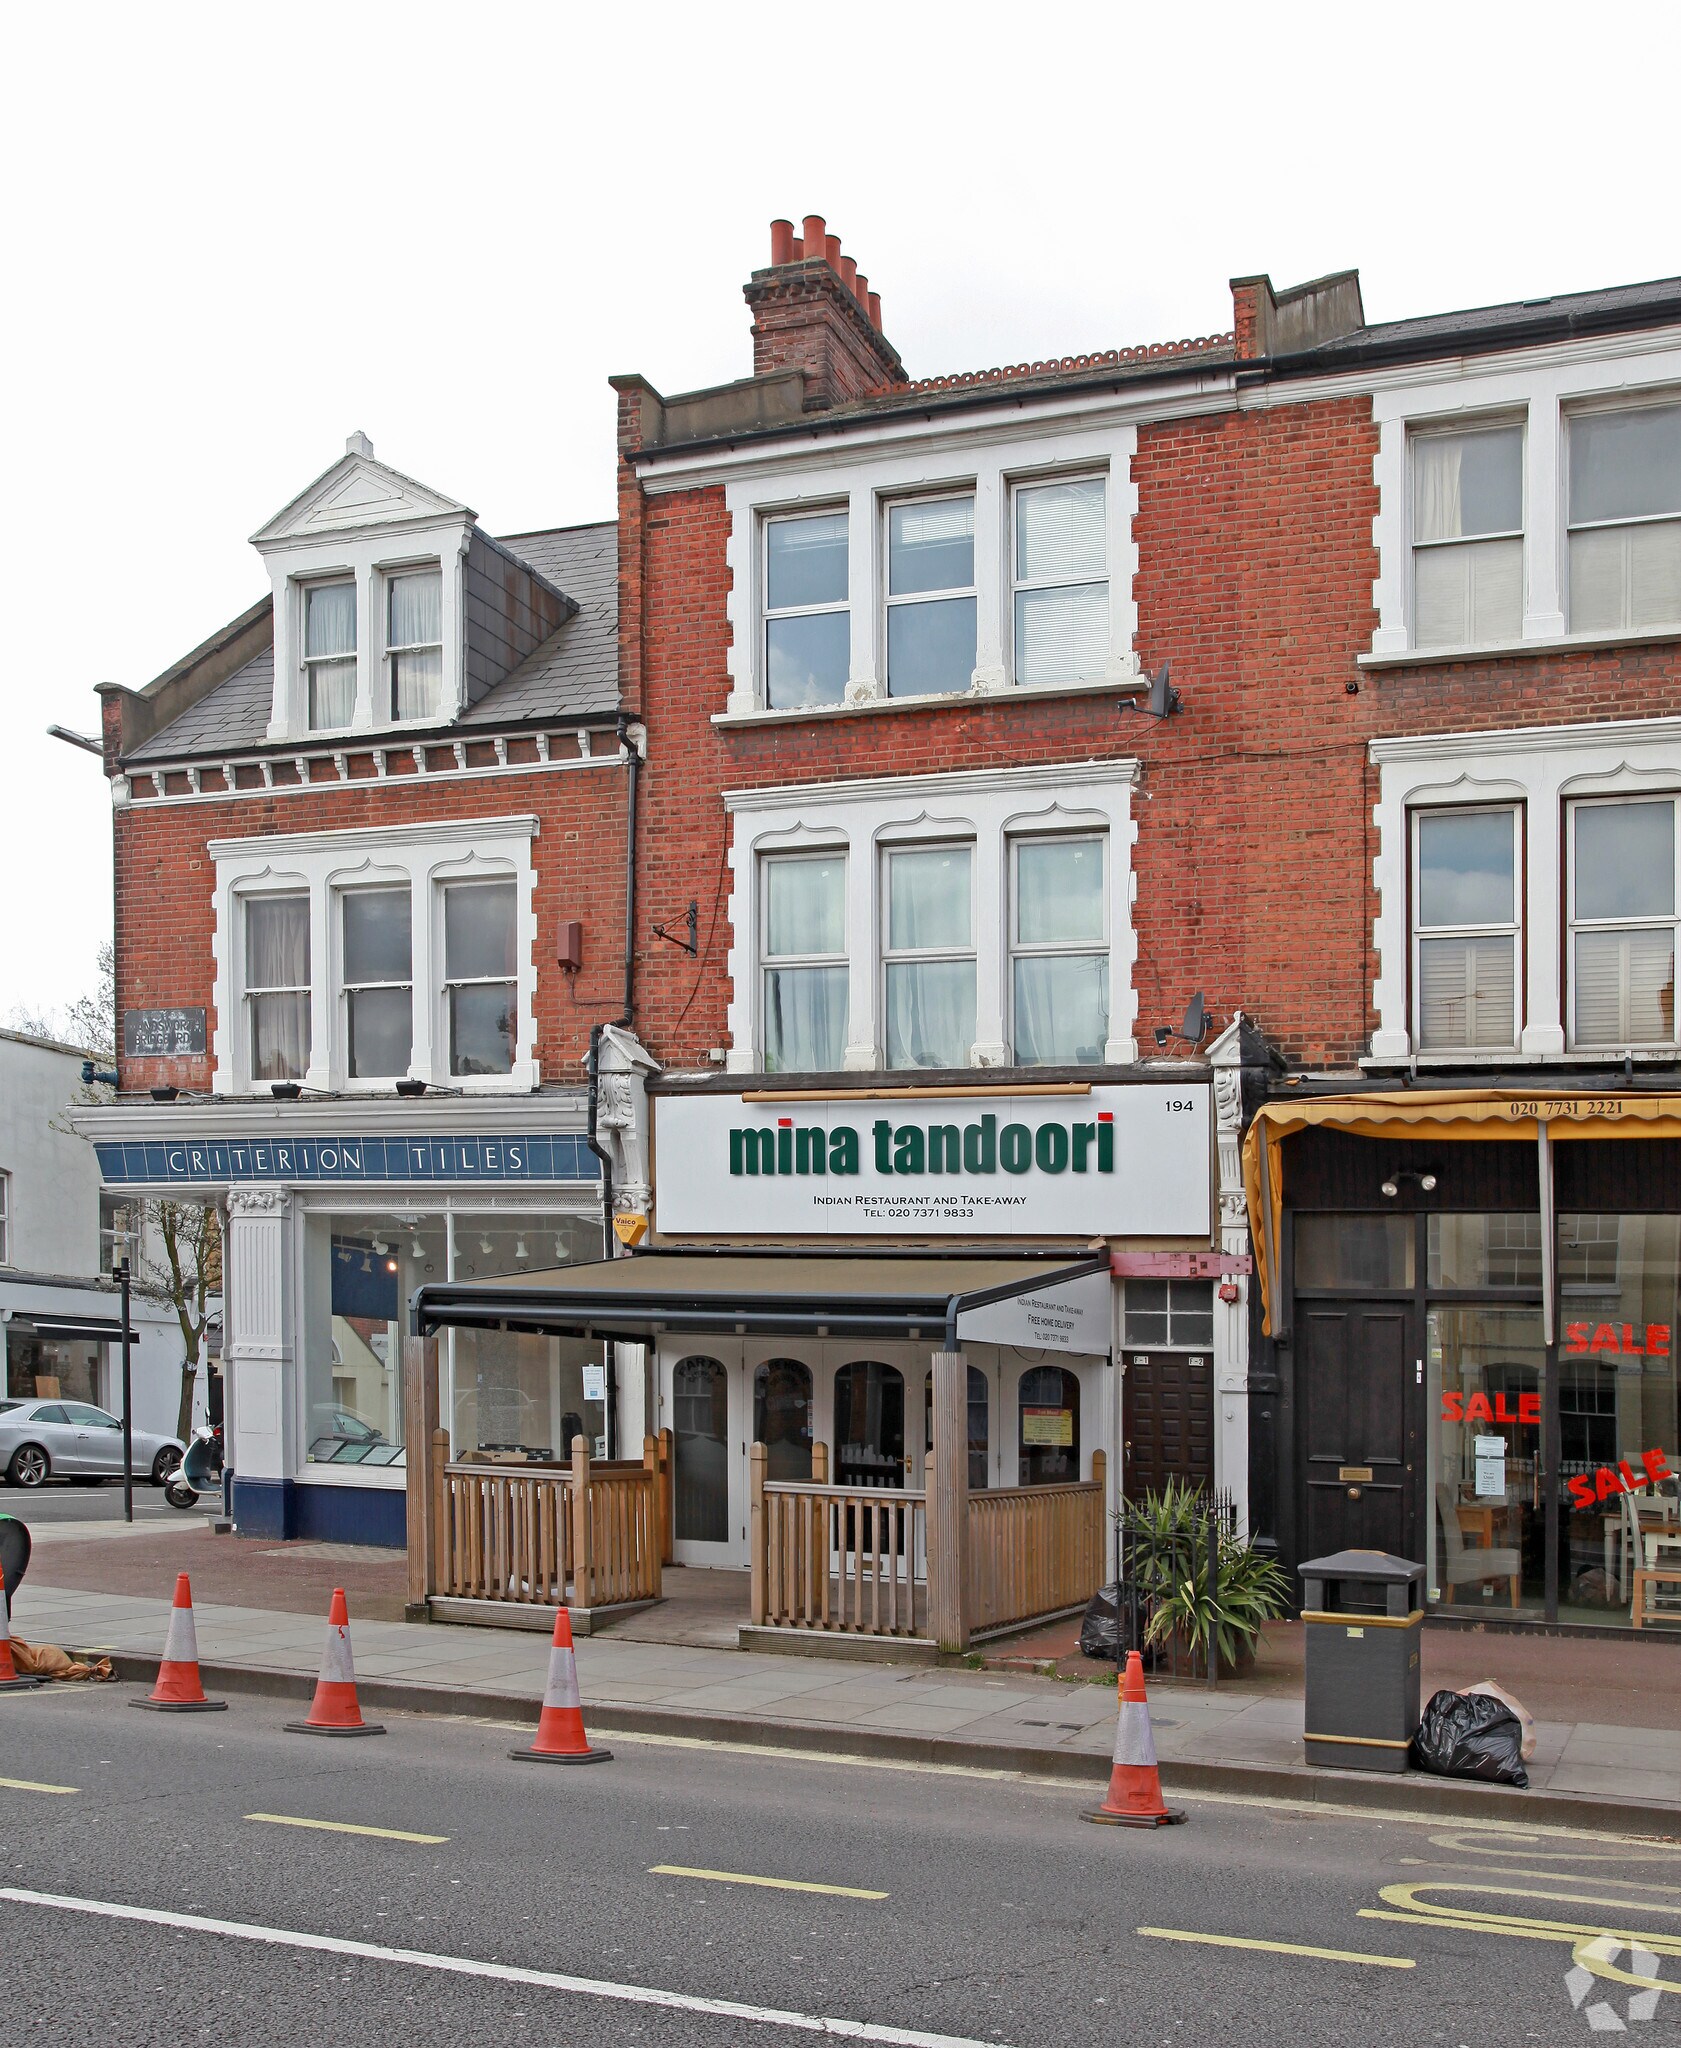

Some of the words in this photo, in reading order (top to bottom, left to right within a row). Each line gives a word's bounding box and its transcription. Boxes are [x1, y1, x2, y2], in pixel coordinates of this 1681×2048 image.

[135, 1033, 169, 1045] BRIDGE
[1165, 1100, 1194, 1112] 194
[1511, 1102, 1538, 1115] 020
[1545, 1101, 1579, 1114] 7731
[1587, 1101, 1623, 1114] 2221
[729, 1118, 859, 1175] mina
[872, 1112, 1114, 1174] tandoori
[169, 1148, 360, 1172] CRITERION
[411, 1147, 522, 1169] TILES
[888, 1208, 911, 1218] 020
[913, 1208, 941, 1218] 7371
[943, 1208, 974, 1218] 9833
[1566, 1323, 1671, 1357] SALE
[1441, 1392, 1542, 1424] SALE
[1567, 1447, 1673, 1510] SALE
